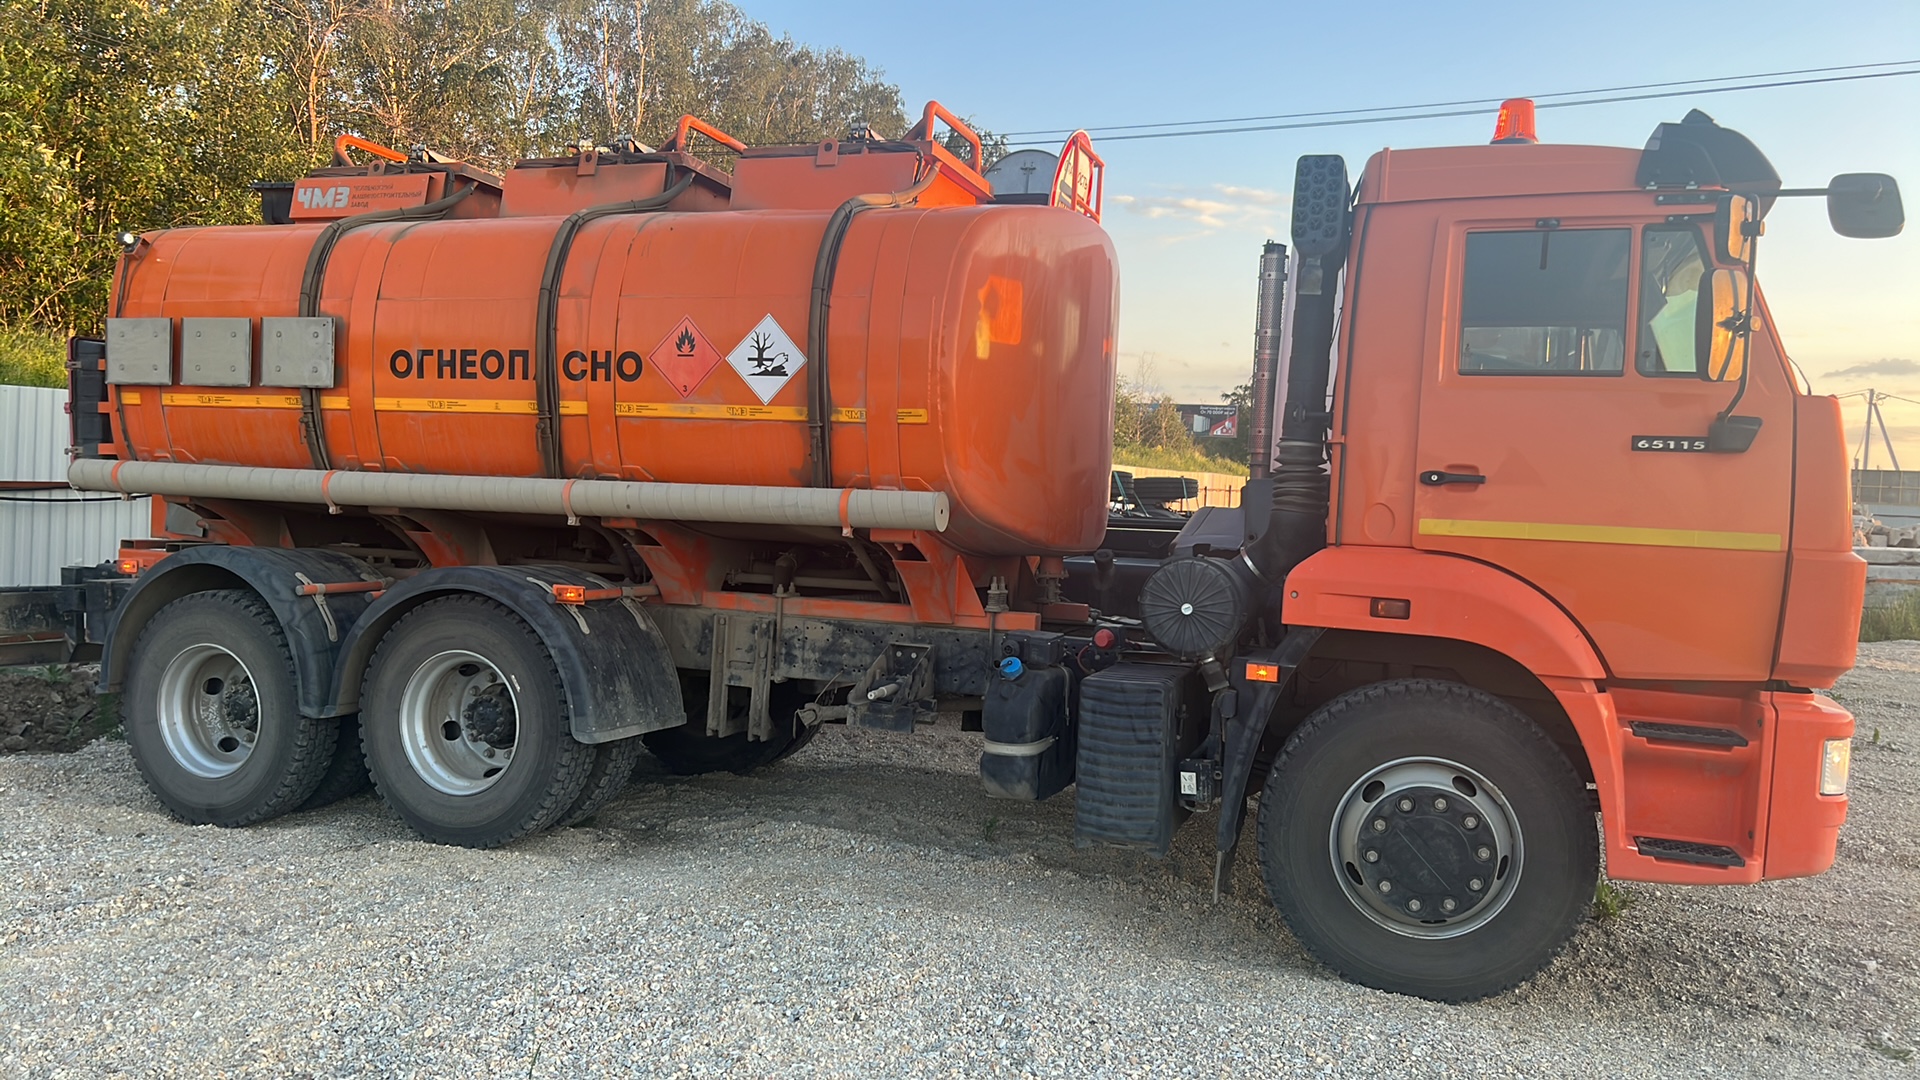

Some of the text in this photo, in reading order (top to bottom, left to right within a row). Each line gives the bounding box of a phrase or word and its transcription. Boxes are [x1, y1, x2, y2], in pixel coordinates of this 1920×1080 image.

[297, 187, 350, 209] ЧМЗ
[389, 349, 643, 382] ОГНЕОПСНО
[682, 384, 688, 393] 3
[427, 400, 446, 409] ЧМЗ
[615, 403, 635, 413] ЧМЗ
[726, 406, 748, 416] ЧМЗ
[1637, 440, 1705, 450] 65115
